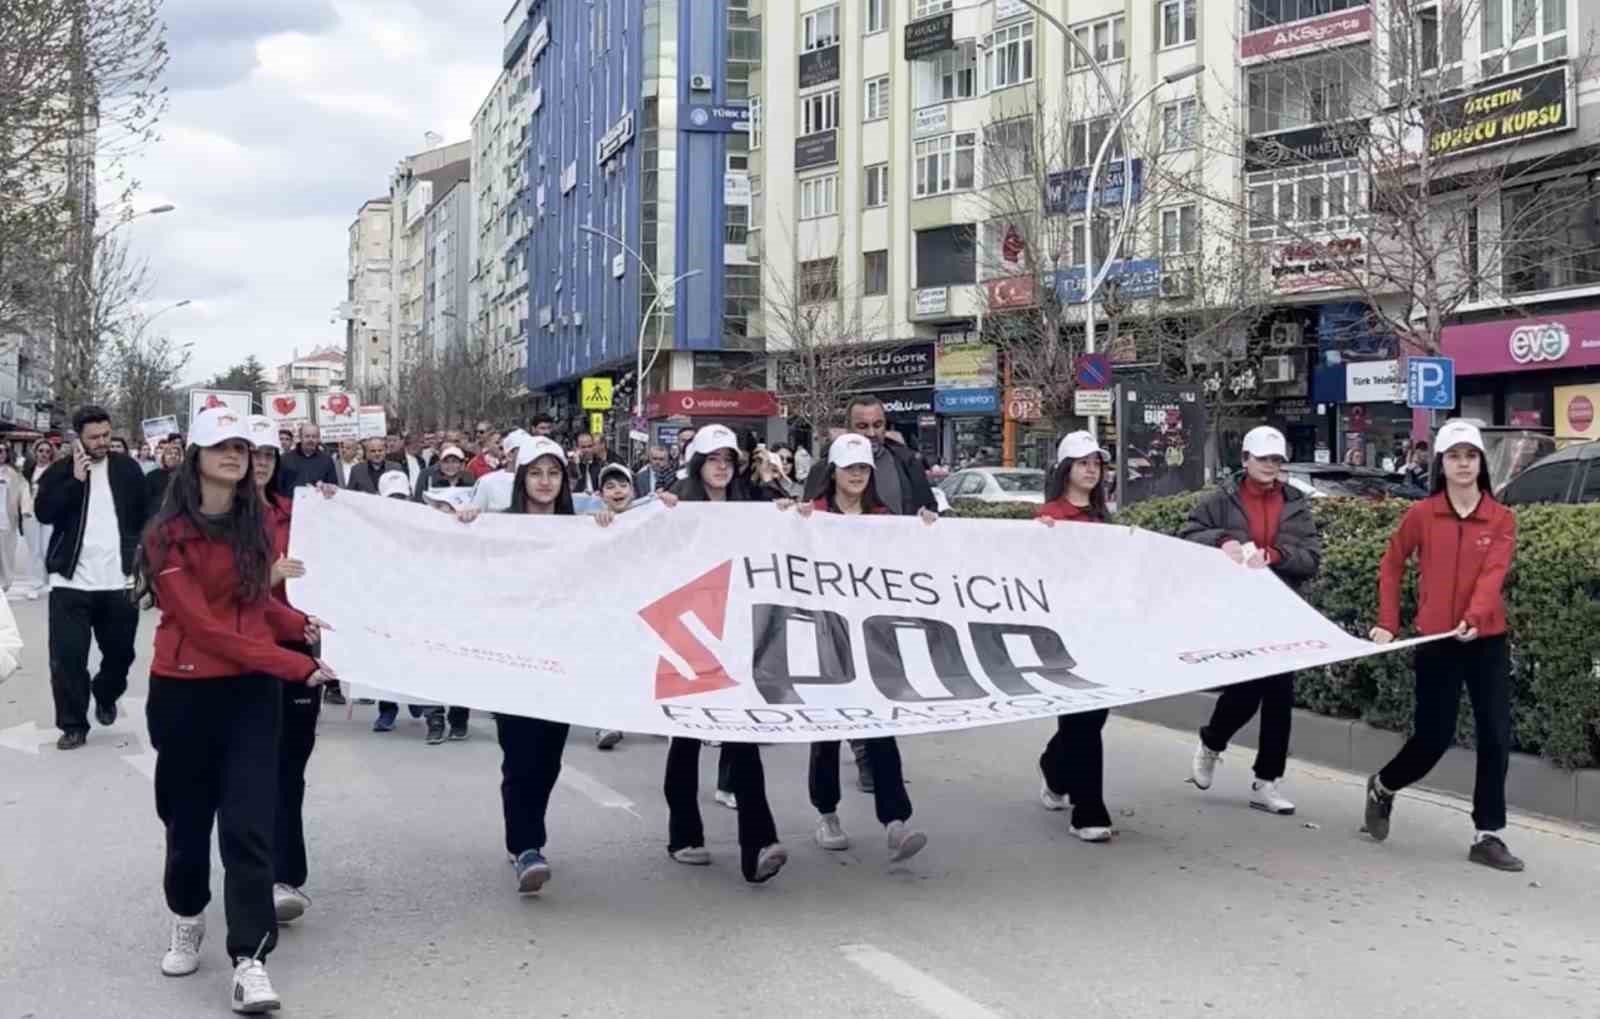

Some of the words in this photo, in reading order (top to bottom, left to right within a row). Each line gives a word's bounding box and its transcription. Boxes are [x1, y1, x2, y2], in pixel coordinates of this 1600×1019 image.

[1502, 103, 1562, 135] KURSU
[1511, 328, 1562, 360] eve
[1418, 363, 1443, 403] P
[697, 400, 739, 408] vodafone
[744, 553, 940, 606] HERKES
